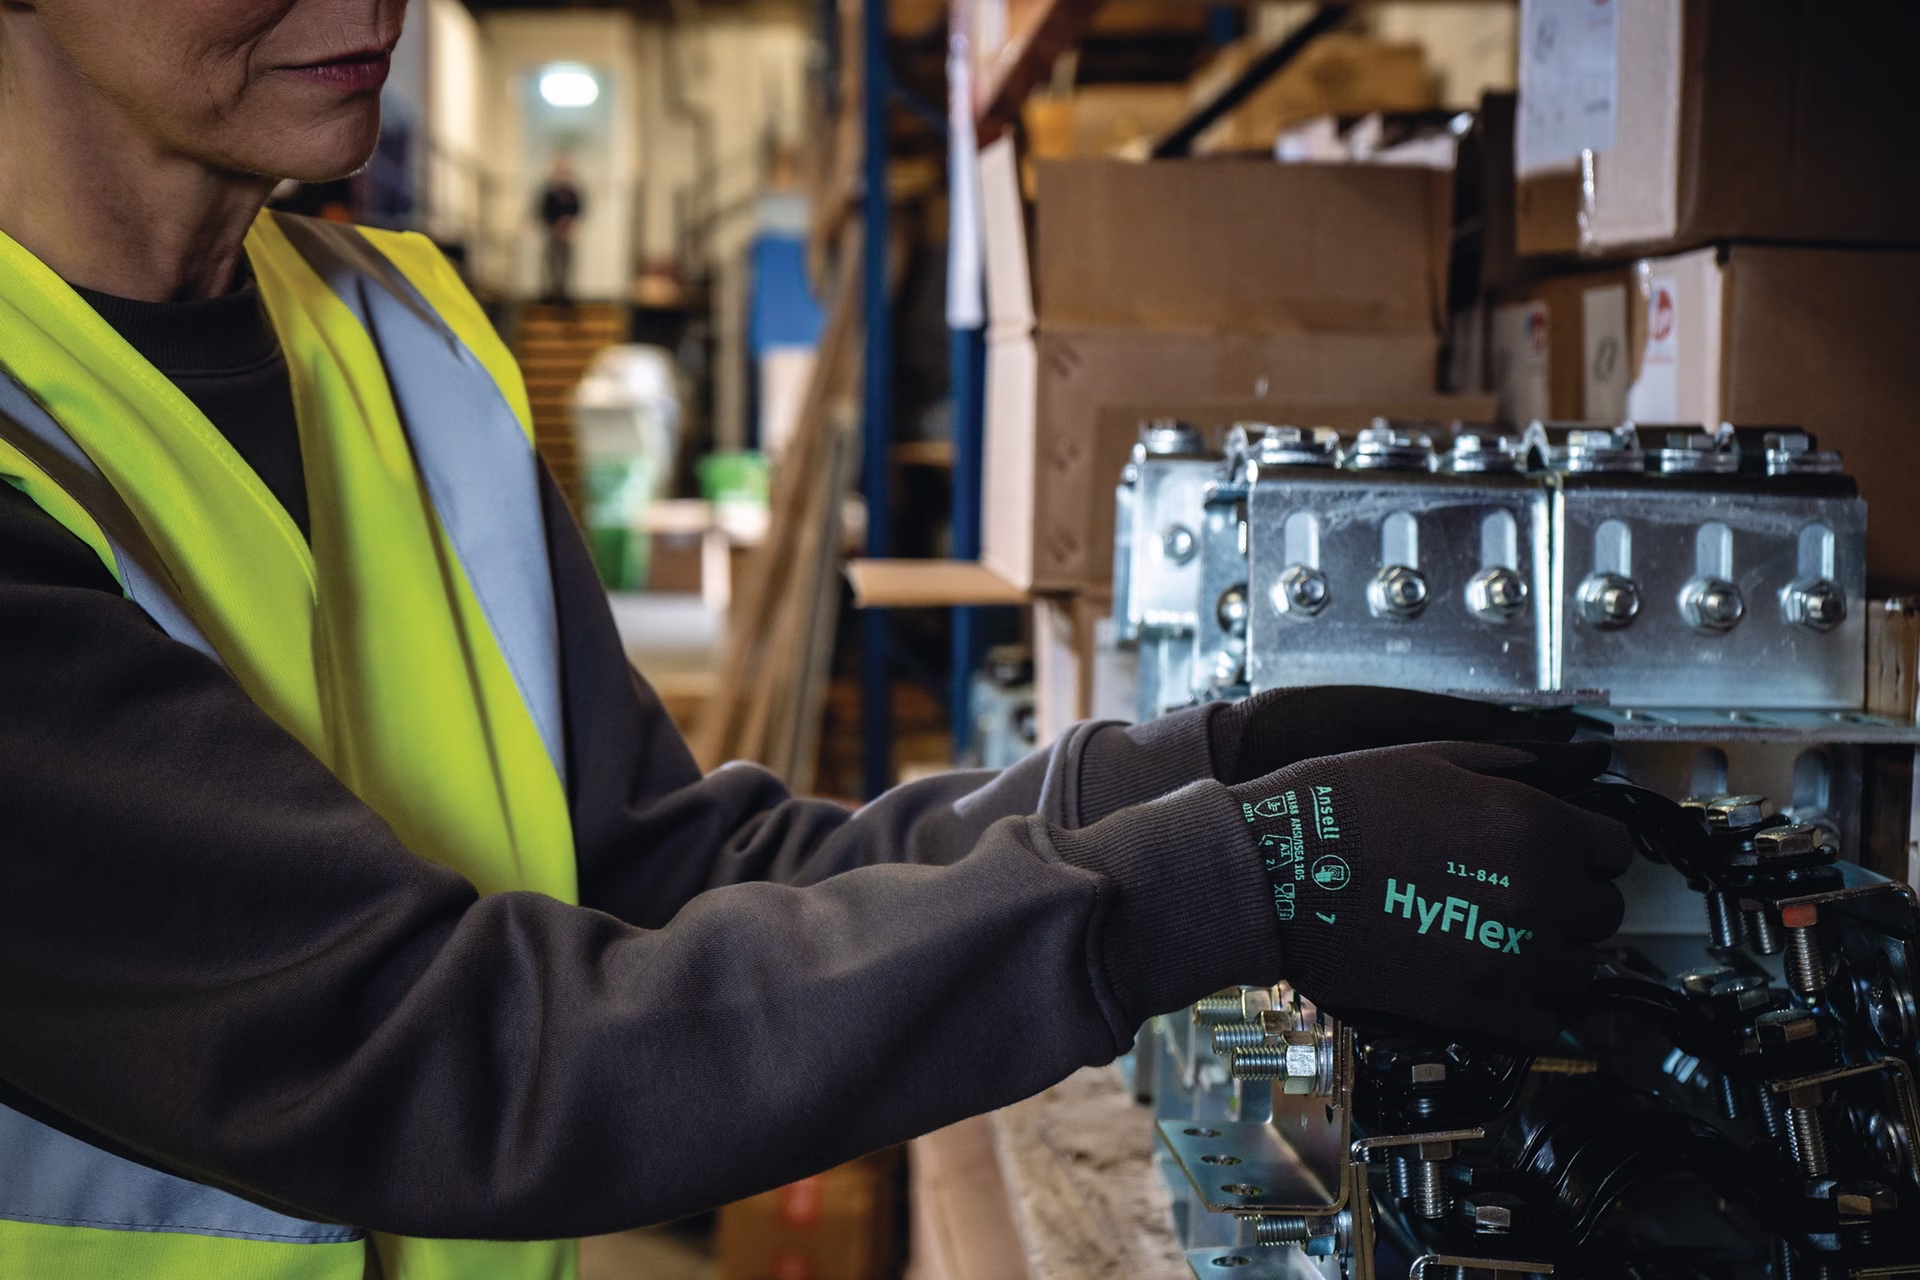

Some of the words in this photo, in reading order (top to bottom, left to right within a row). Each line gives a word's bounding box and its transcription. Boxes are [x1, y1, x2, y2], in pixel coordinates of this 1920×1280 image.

[1285, 790, 1299, 815] EN388
[1315, 785, 1340, 840] Ansell
[1280, 842, 1291, 858] A1
[1290, 817, 1305, 862] ANSI/ISEA
[1294, 863, 1305, 881] 105
[1447, 861, 1510, 888] 11-844
[1315, 911, 1336, 924] 7
